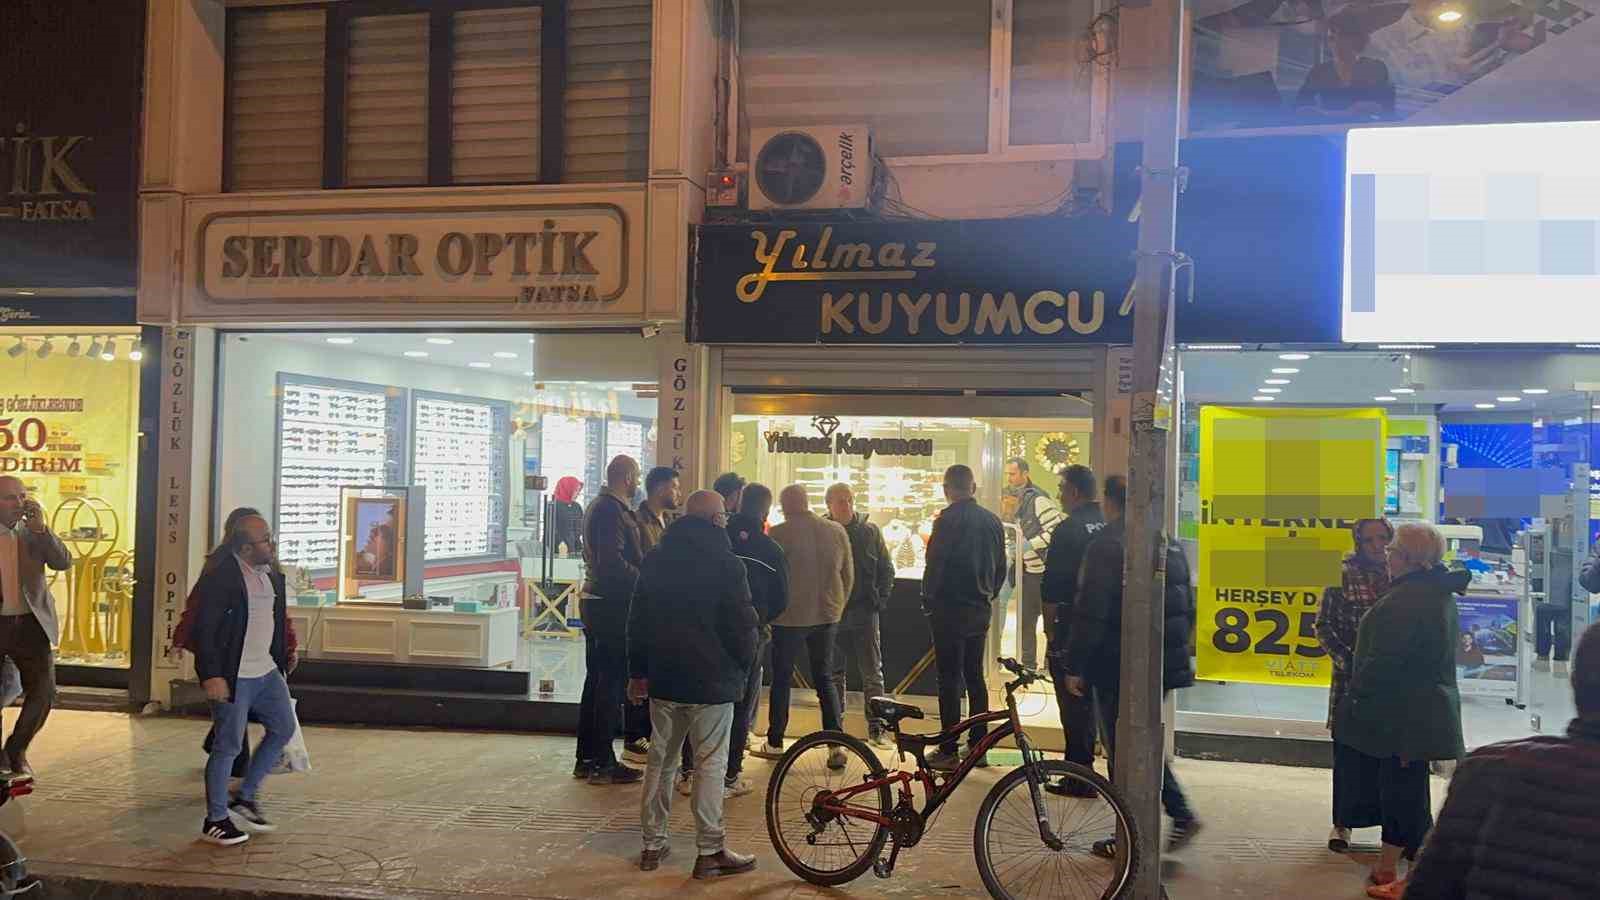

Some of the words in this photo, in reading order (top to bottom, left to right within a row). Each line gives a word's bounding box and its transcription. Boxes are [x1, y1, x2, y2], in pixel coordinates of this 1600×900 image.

[0, 122, 96, 194] İK
[839, 132, 855, 185] arçelik
[221, 233, 423, 279] SERDAR
[435, 219, 600, 277] OPTİK
[735, 226, 936, 302] Yılmaz
[821, 290, 1105, 335] KUYUMCU
[171, 347, 184, 449] GÖZLÜK
[673, 358, 687, 469] GÖZLÜK
[168, 476, 180, 543] LENS
[1216, 588, 1298, 607] HERŞEY
[1212, 607, 1328, 657] 825
